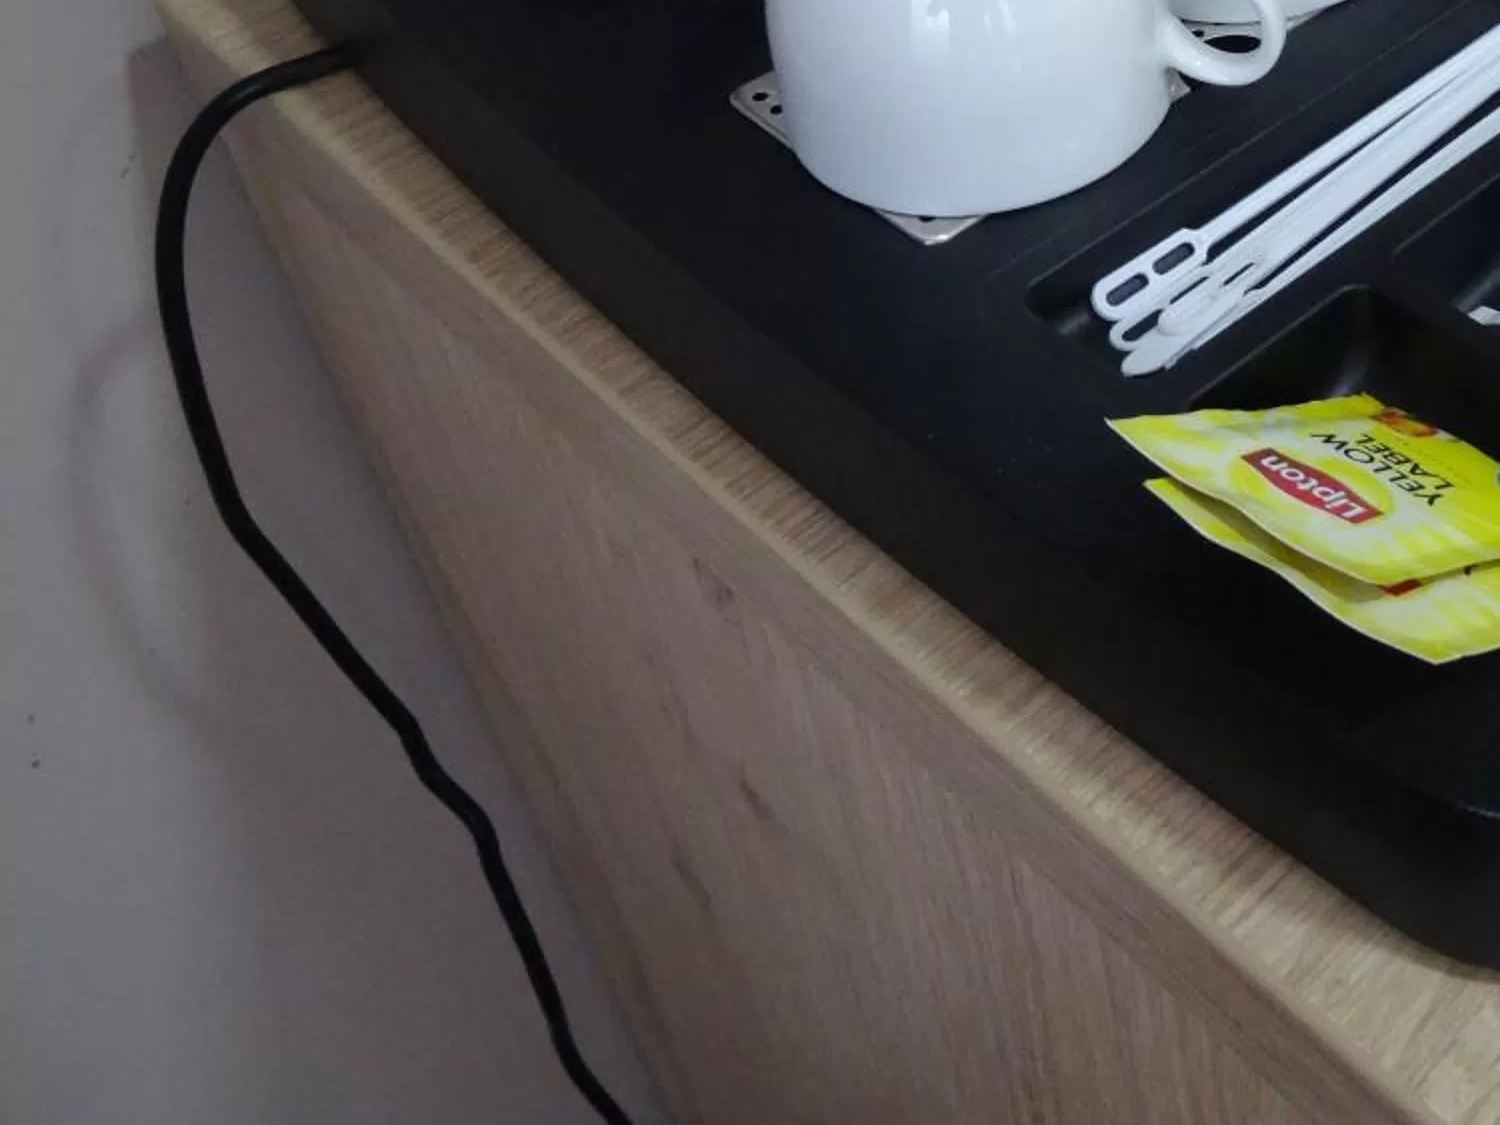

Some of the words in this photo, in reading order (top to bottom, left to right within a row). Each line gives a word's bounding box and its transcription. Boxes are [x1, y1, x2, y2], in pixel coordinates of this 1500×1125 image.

[1258, 454, 1370, 518] Lipton
[1308, 431, 1445, 507] YELLOW
[1354, 432, 1455, 491] LABEL
